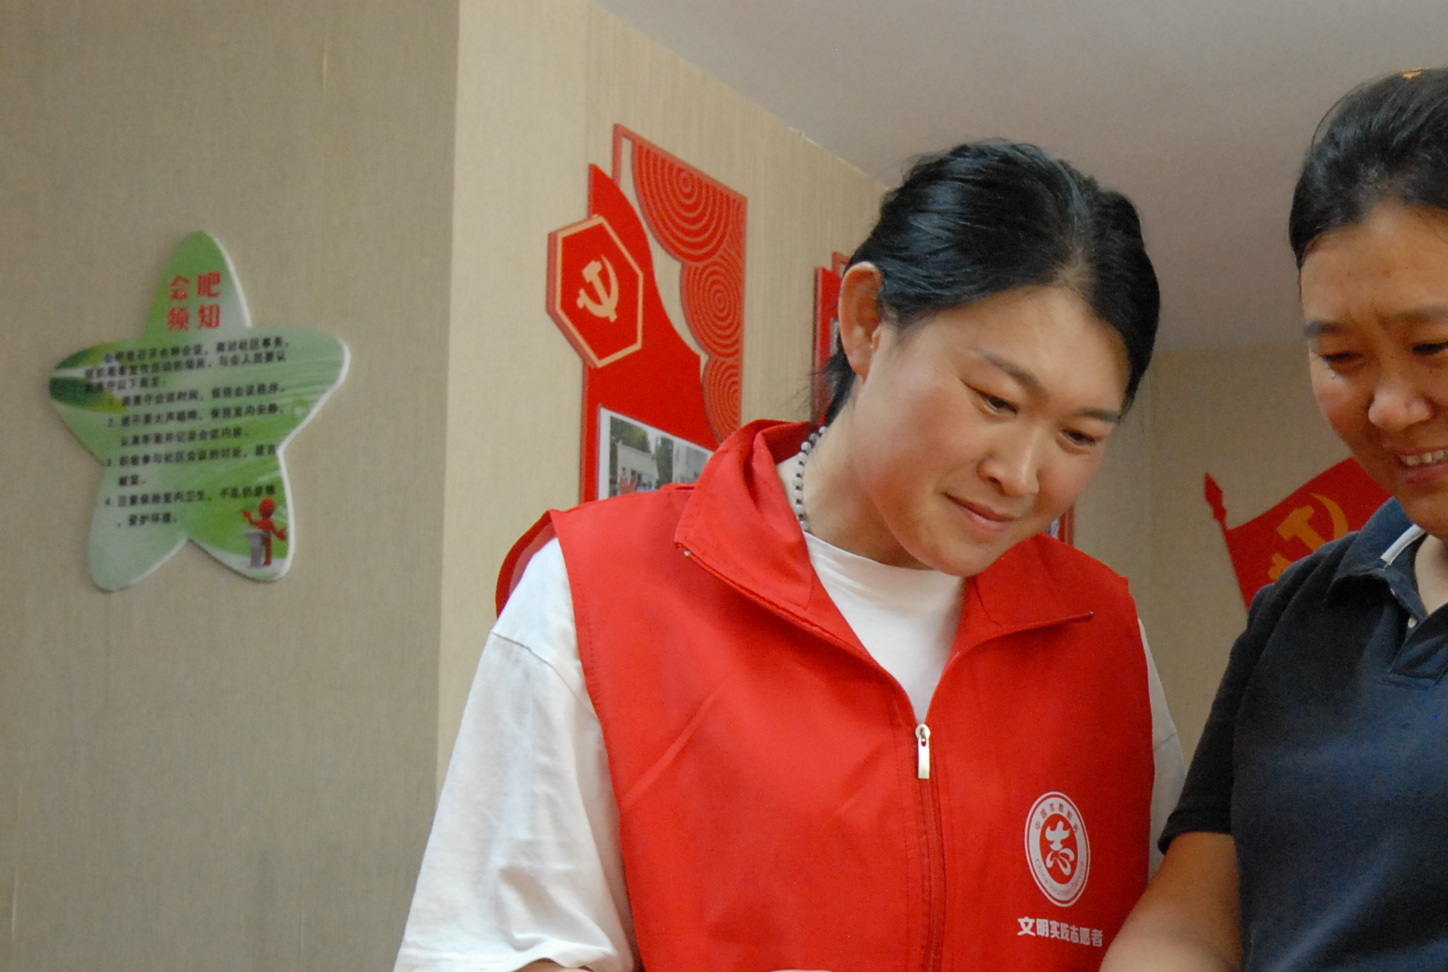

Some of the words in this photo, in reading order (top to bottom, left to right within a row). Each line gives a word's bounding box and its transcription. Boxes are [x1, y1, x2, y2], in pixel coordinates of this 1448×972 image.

[168, 272, 221, 300] 会吧
[167, 304, 221, 331] 须知
[1017, 916, 1104, 947] 文明实践志愿者
